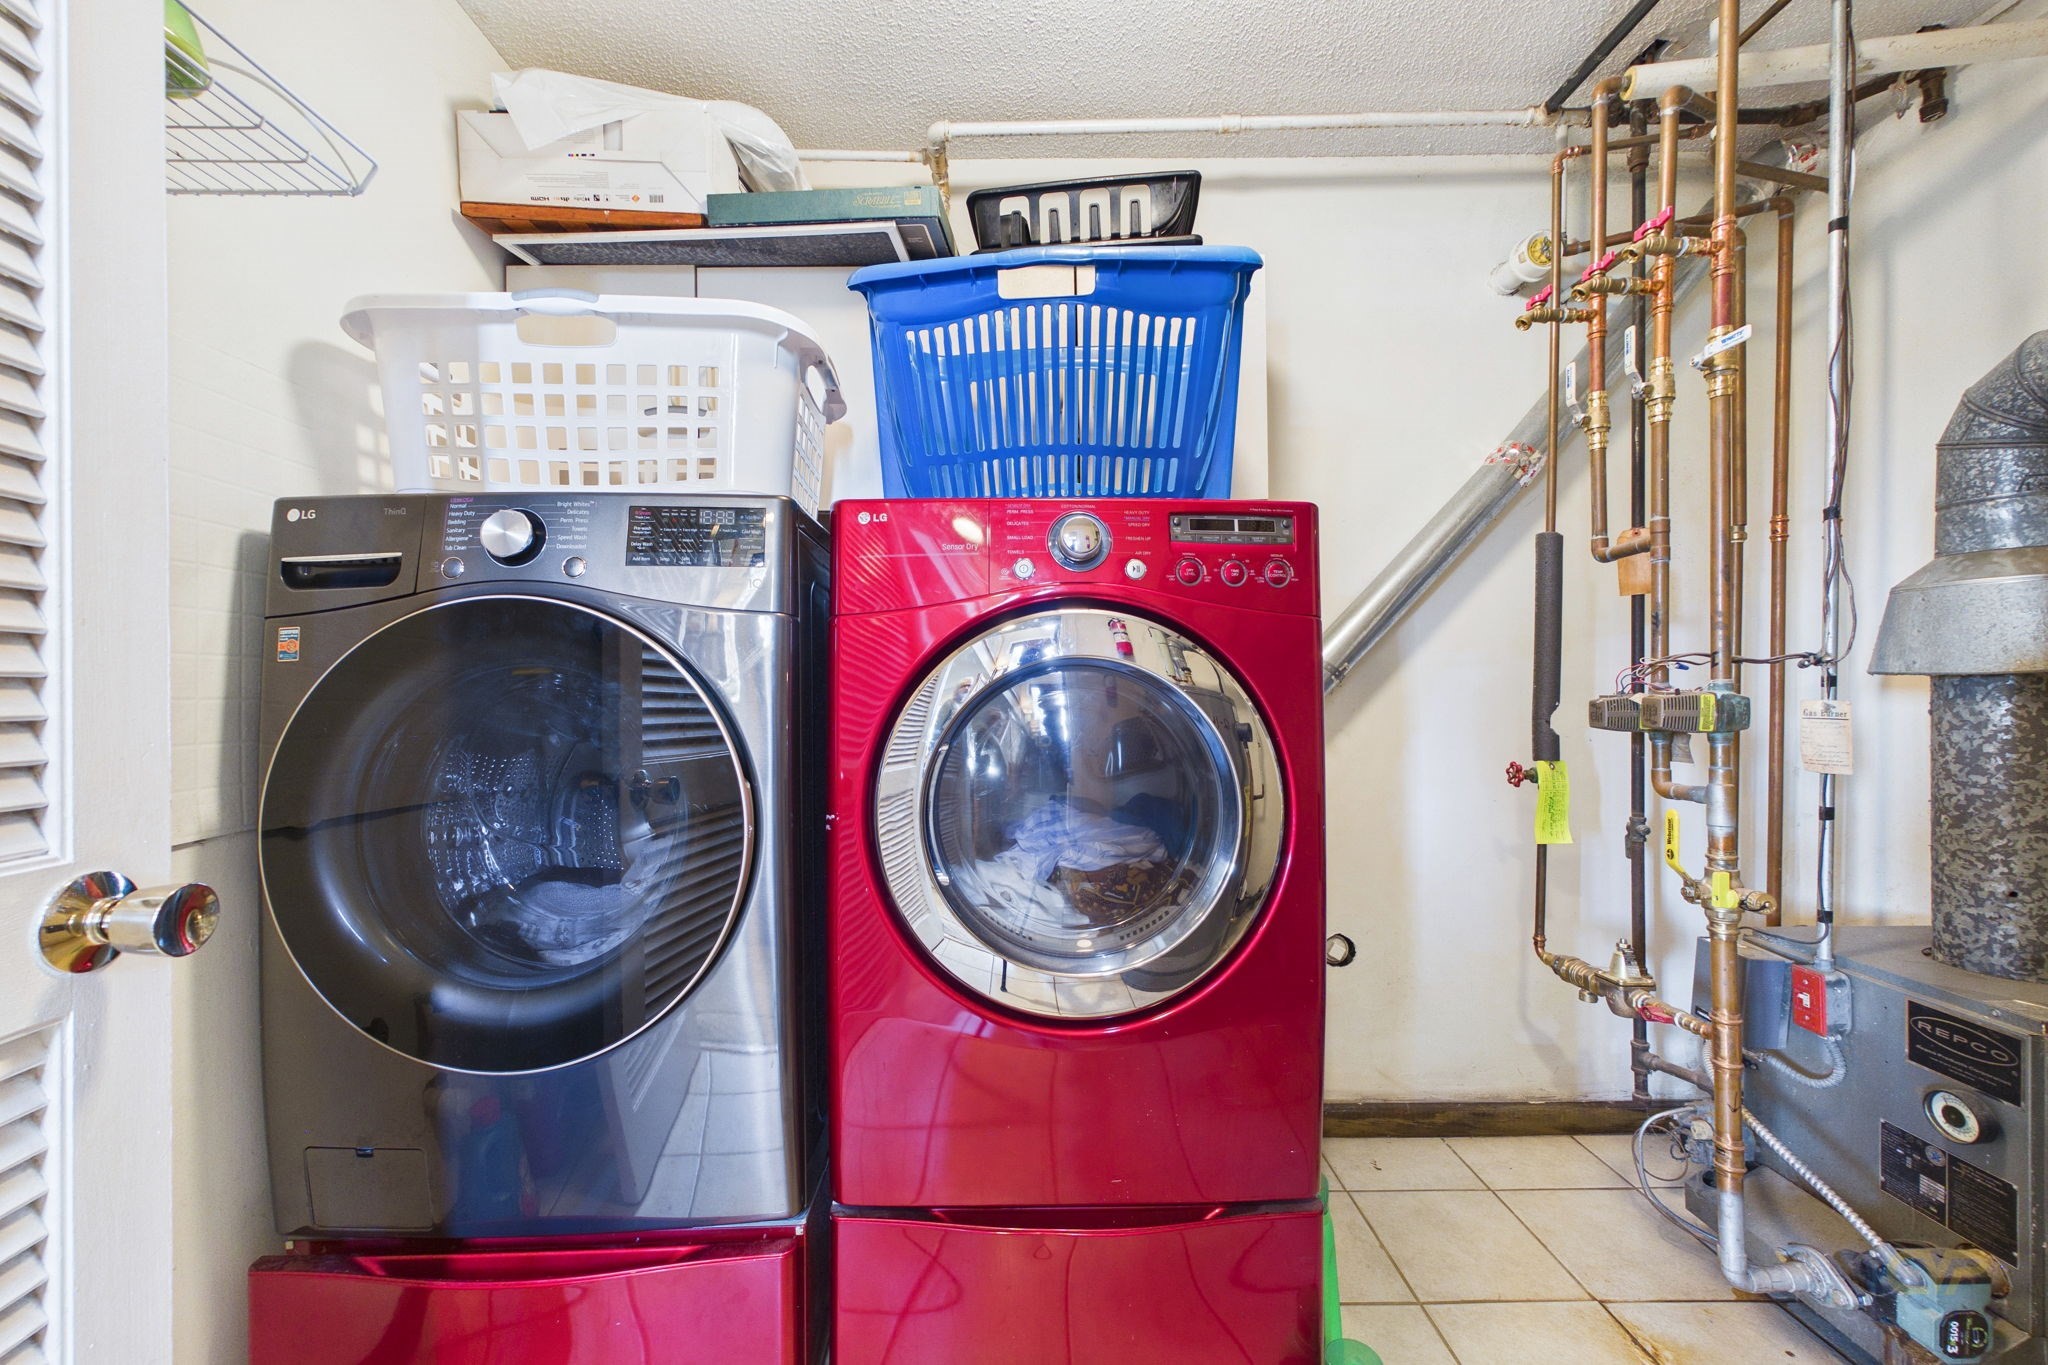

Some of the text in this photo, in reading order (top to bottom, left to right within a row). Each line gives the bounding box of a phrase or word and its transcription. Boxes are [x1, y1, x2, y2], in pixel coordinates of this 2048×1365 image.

[301, 509, 316, 519] LG
[383, 507, 406, 515] ThinQ
[873, 513, 888, 522] LG
[942, 543, 979, 552] Sensor Dry
[1803, 708, 1817, 717] Gas
[1918, 1020, 2009, 1062] REPCO
